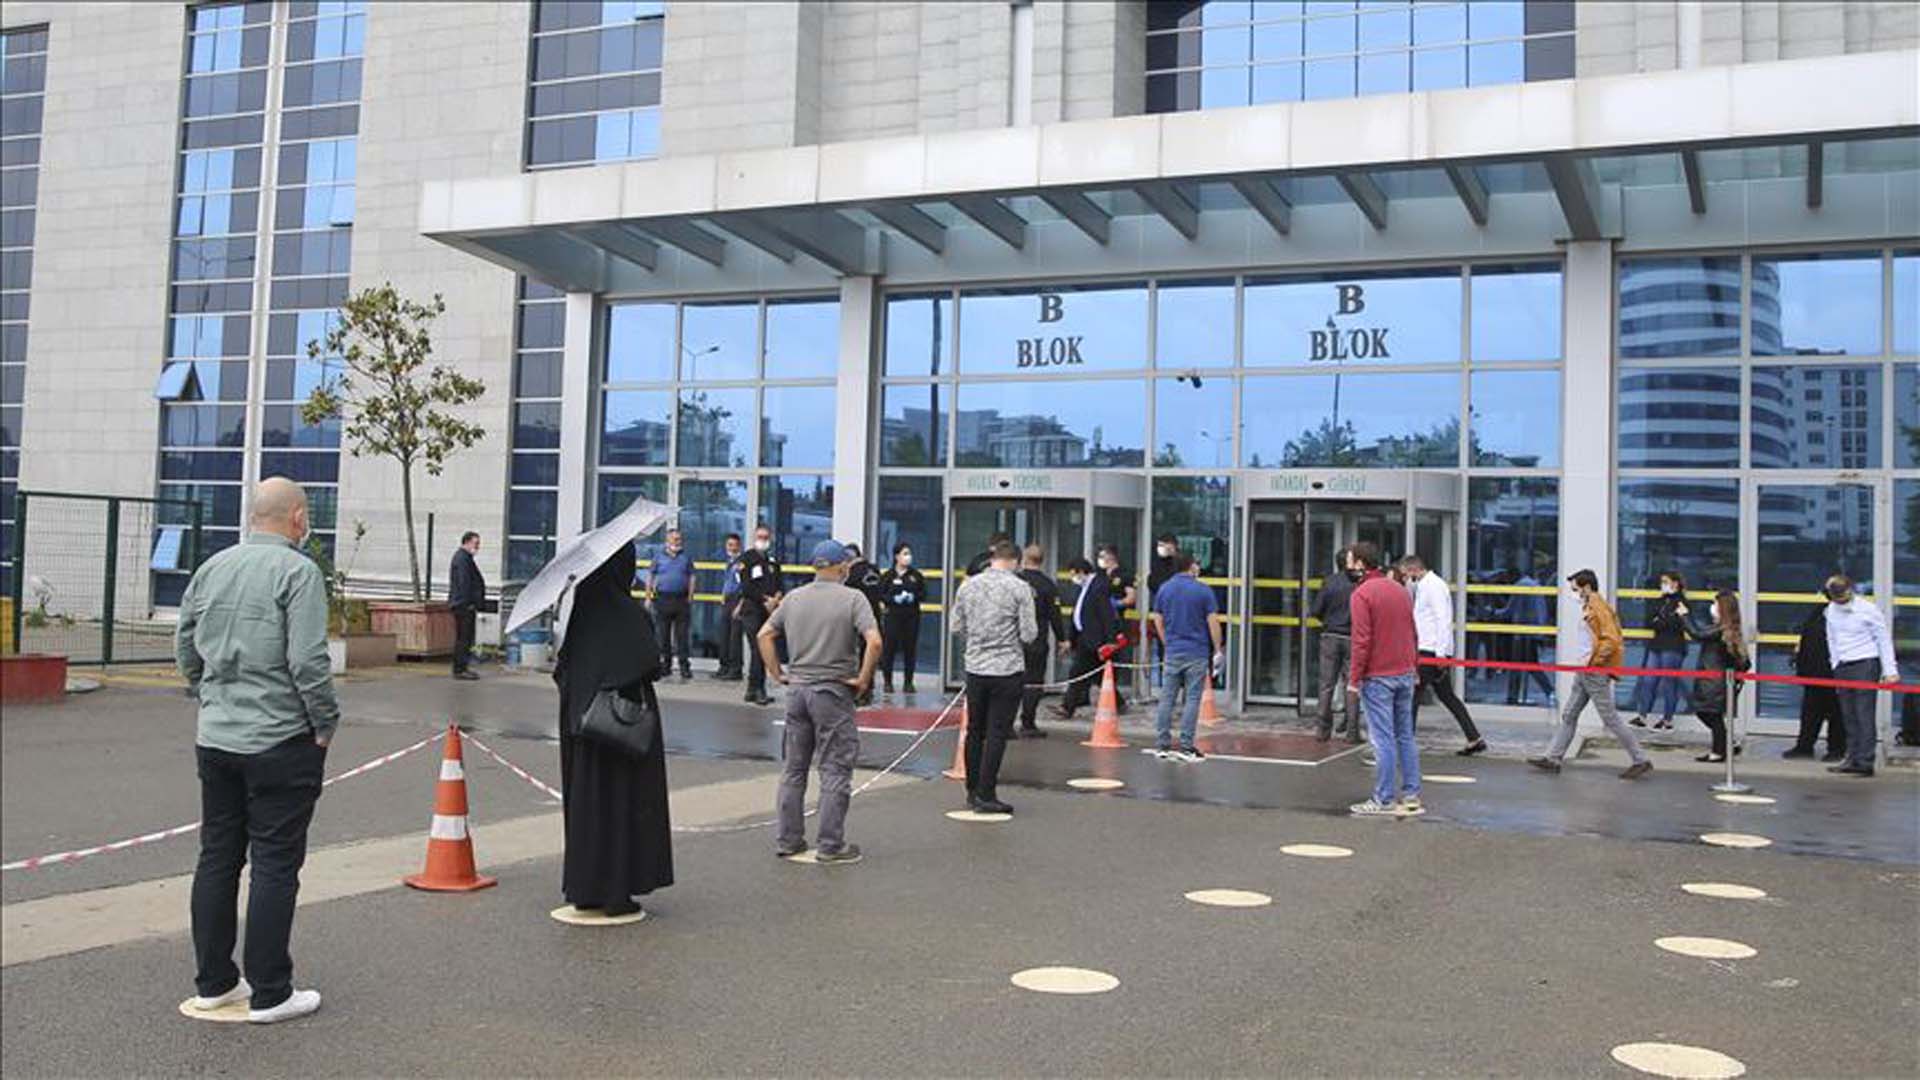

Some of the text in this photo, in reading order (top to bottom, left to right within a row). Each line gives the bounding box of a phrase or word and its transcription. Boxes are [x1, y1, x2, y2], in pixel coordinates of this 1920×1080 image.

[1038, 294, 1064, 323] B
[1335, 284, 1366, 316] B
[1016, 336, 1085, 368] BLOK
[1309, 328, 1391, 361] BLOK
